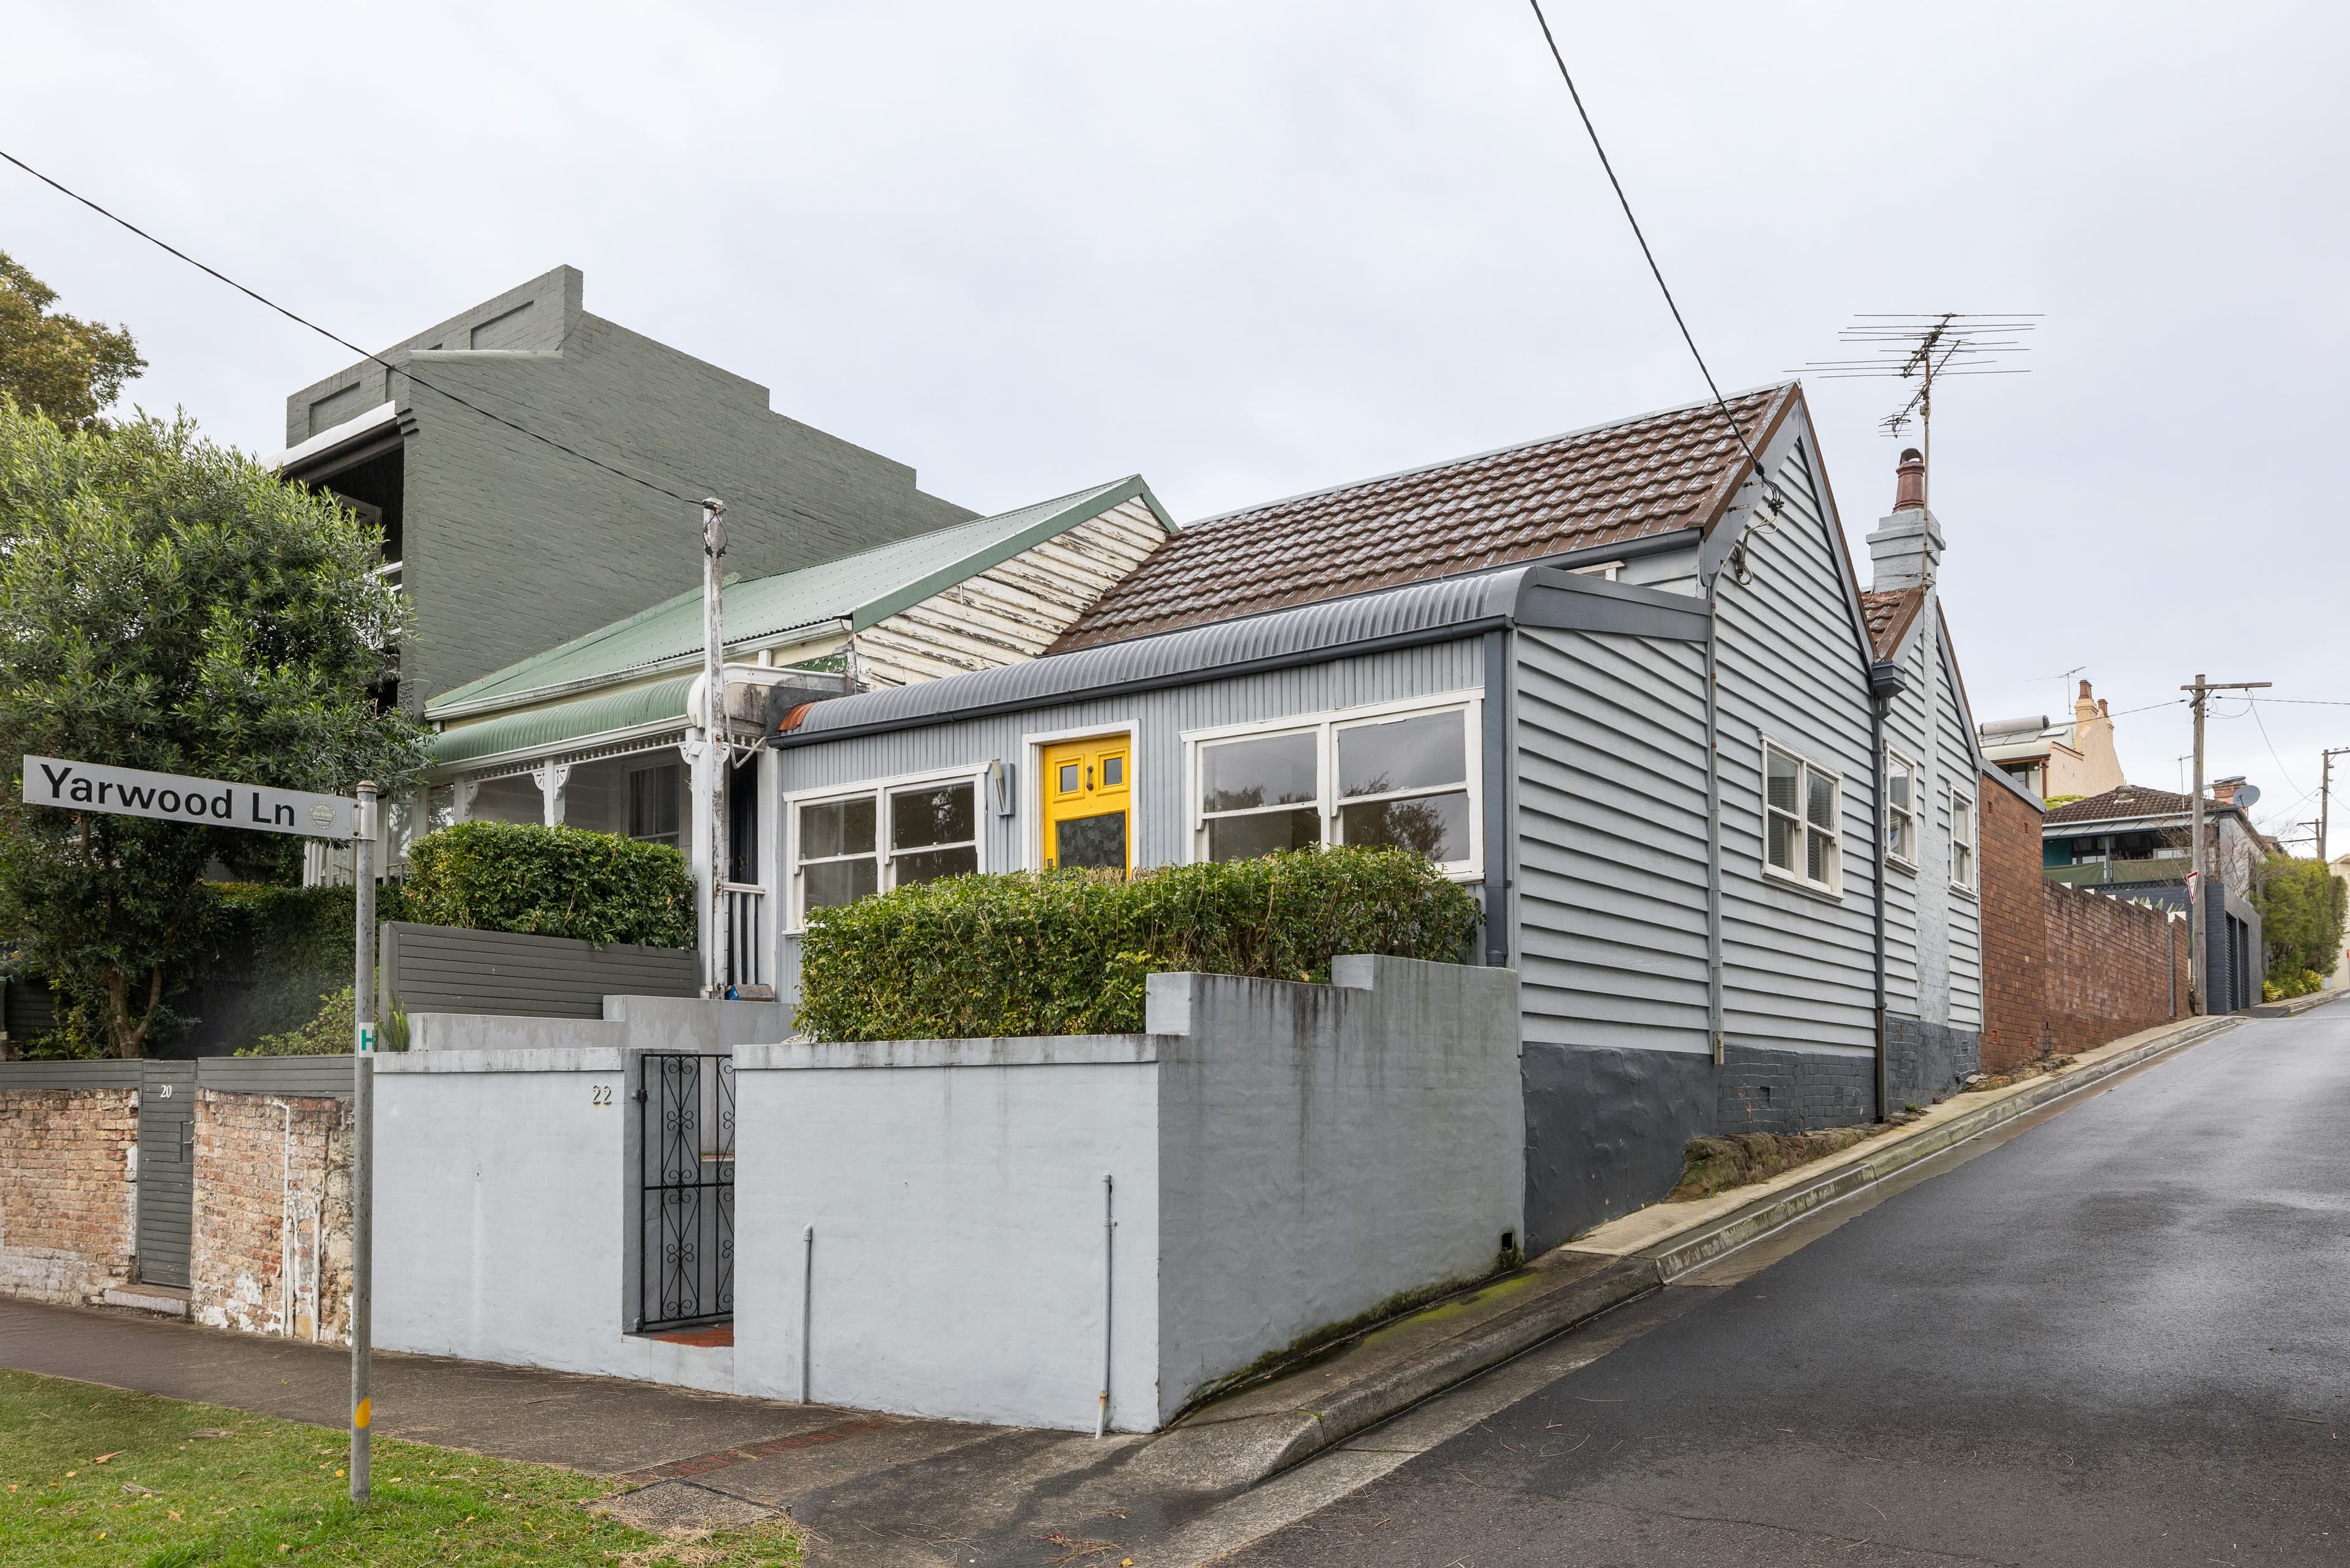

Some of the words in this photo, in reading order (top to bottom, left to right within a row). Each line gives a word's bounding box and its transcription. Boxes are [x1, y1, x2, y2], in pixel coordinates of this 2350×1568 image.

[40, 764, 233, 819] Yarwood
[252, 792, 295, 826] Ln
[361, 1029, 374, 1051] H
[160, 1085, 172, 1098] 20
[593, 1085, 612, 1105] 22
